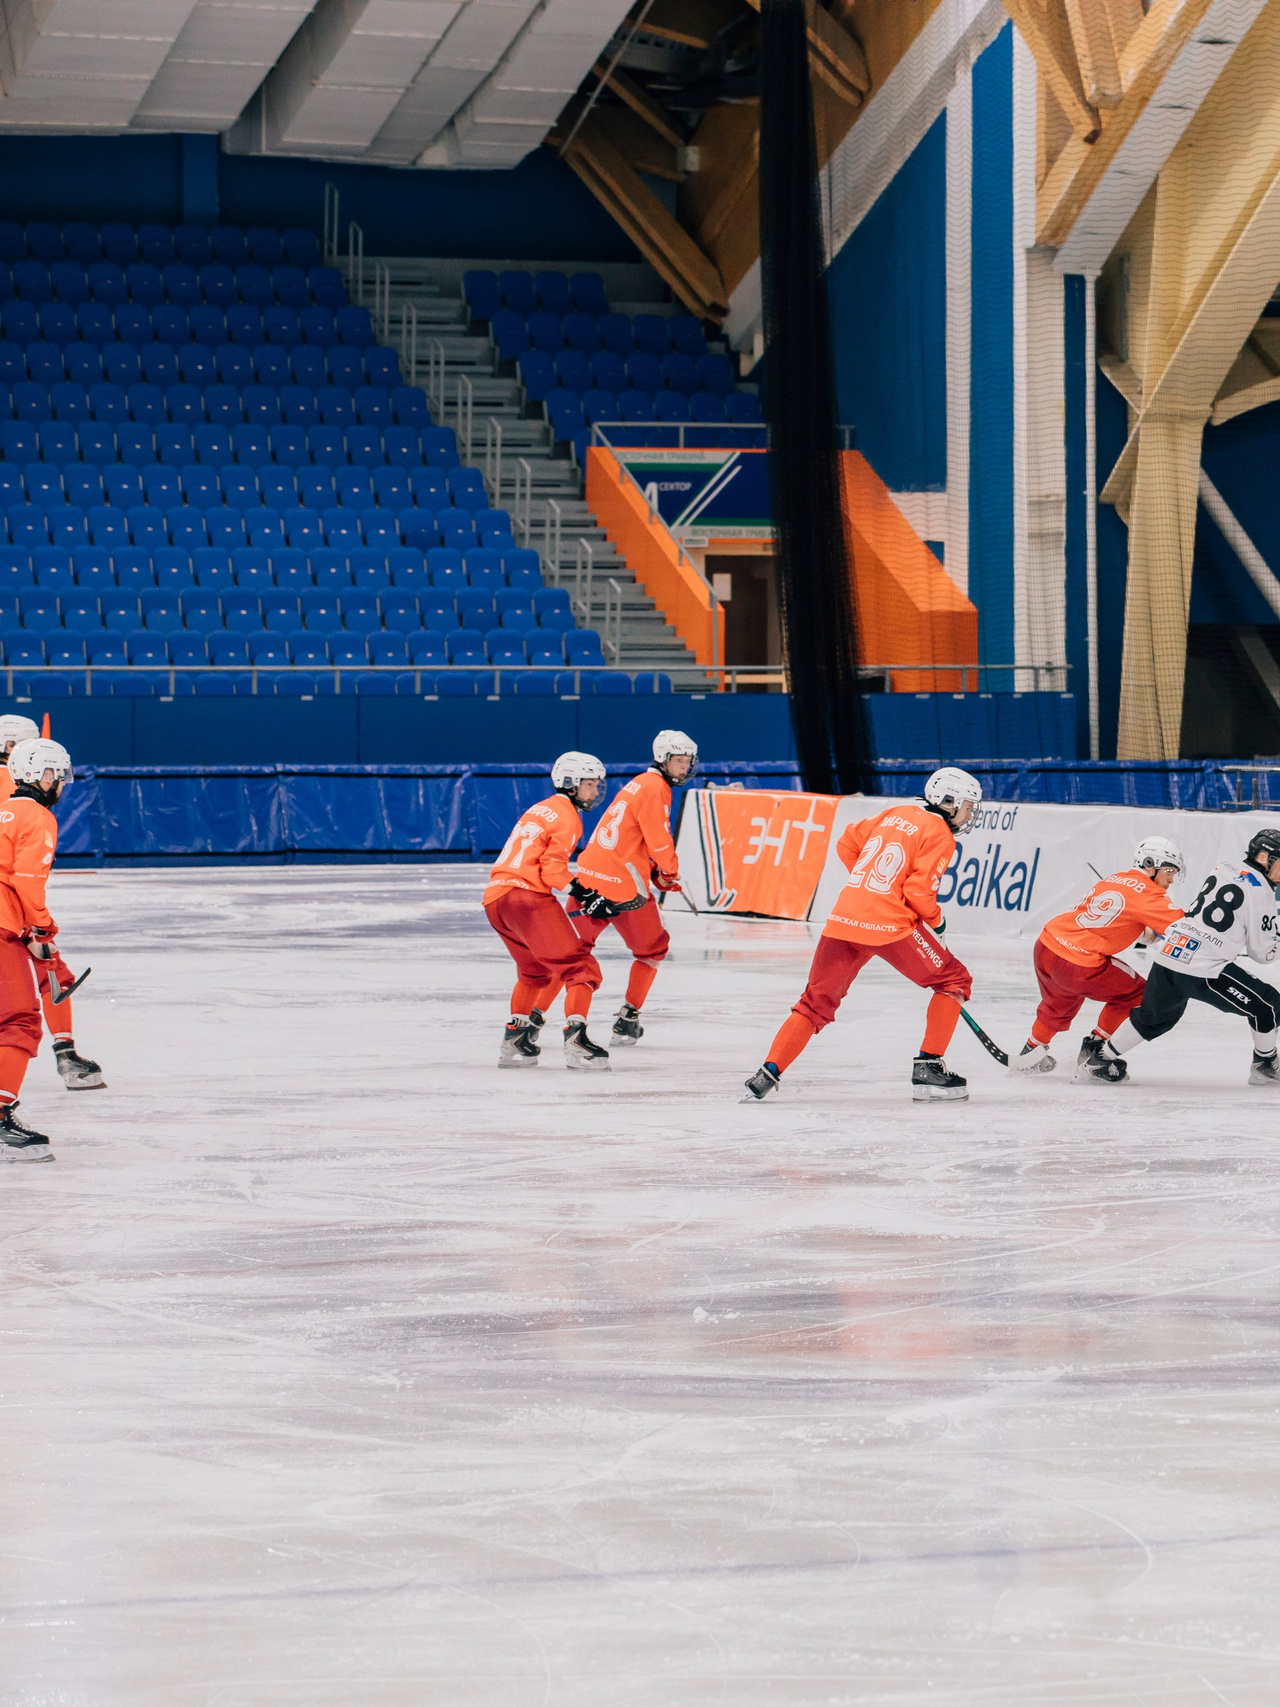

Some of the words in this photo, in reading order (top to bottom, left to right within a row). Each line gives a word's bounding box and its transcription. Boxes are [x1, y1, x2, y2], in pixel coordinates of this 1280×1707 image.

[658, 482, 692, 491] СЕКТОР
[1001, 806, 1019, 831] of
[847, 835, 906, 895] 29
[936, 841, 1041, 912] Baikal
[586, 895, 606, 915] CCM
[859, 921, 898, 932] ОБЛАСТЬ
[1226, 986, 1252, 1005] STEX
